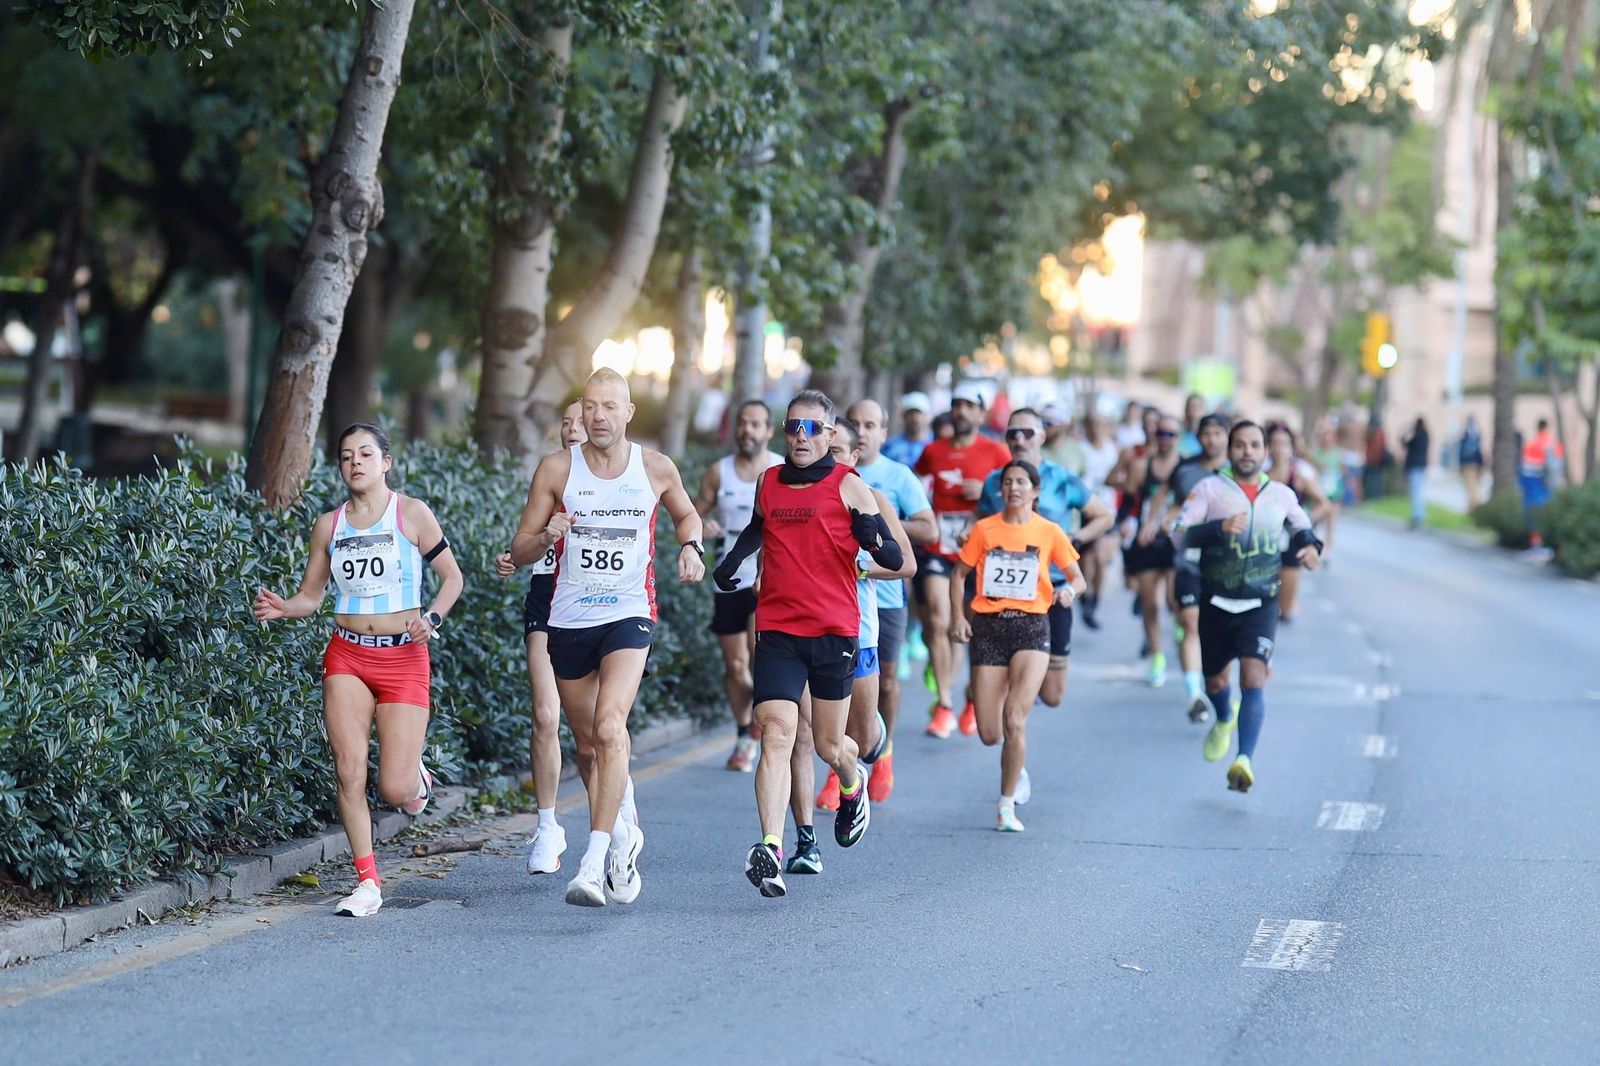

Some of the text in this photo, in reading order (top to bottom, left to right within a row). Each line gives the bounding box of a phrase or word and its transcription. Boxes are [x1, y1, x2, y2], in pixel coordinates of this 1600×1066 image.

[544, 549, 555, 567] 8
[580, 548, 624, 571] 586
[342, 557, 384, 580] 970
[993, 567, 1028, 585] 257
[335, 628, 413, 648] NDER A
